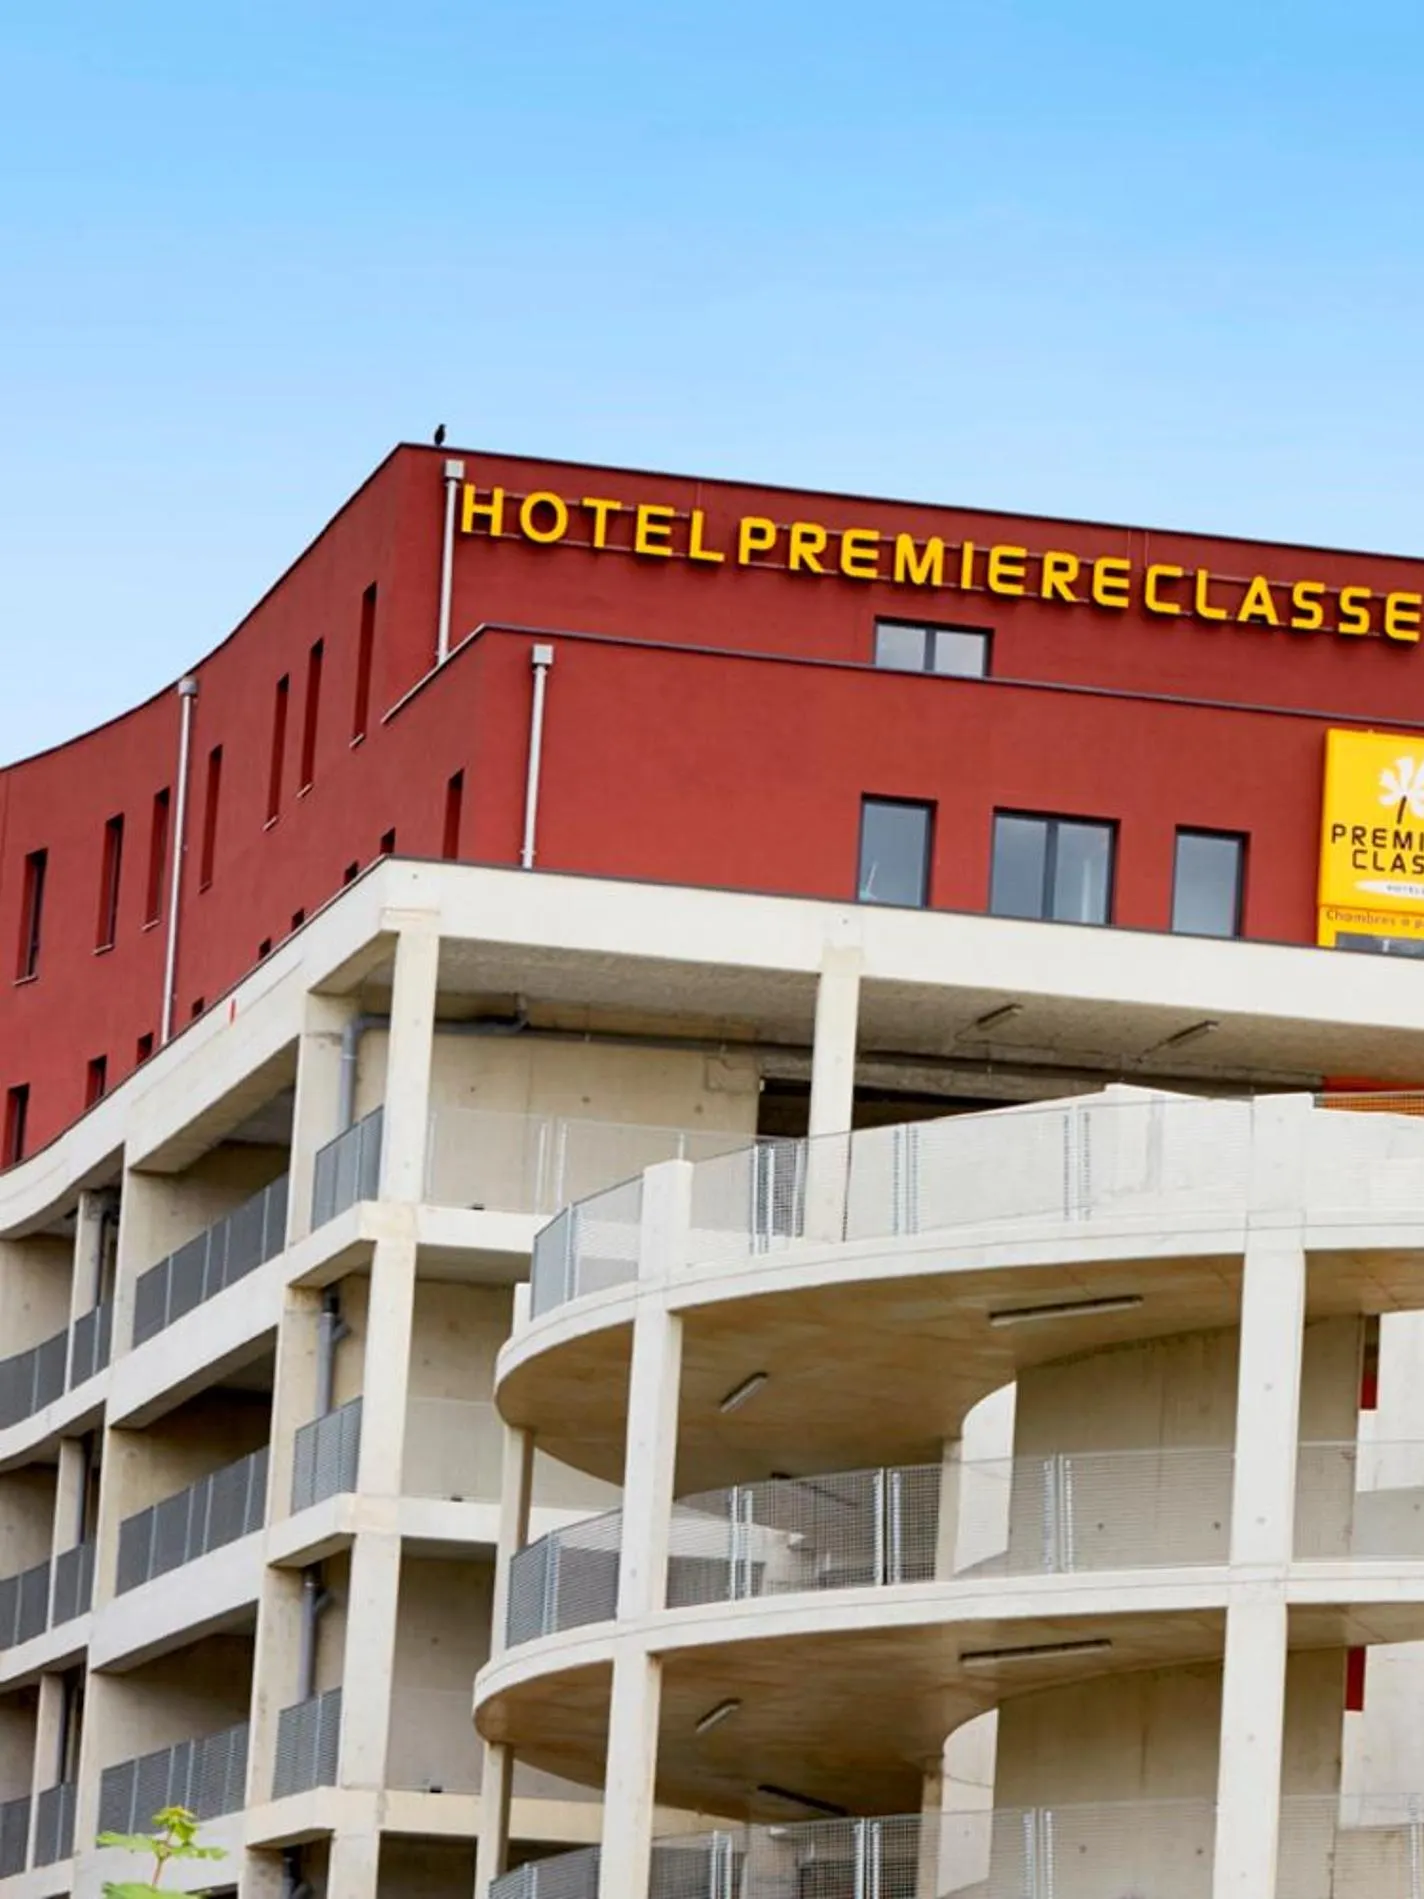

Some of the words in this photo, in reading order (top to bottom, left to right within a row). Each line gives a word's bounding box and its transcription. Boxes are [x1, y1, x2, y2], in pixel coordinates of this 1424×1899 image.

[461, 483, 724, 562] HOTEL
[739, 516, 1132, 608] PREMIERE
[1144, 564, 1422, 642] CLASSE
